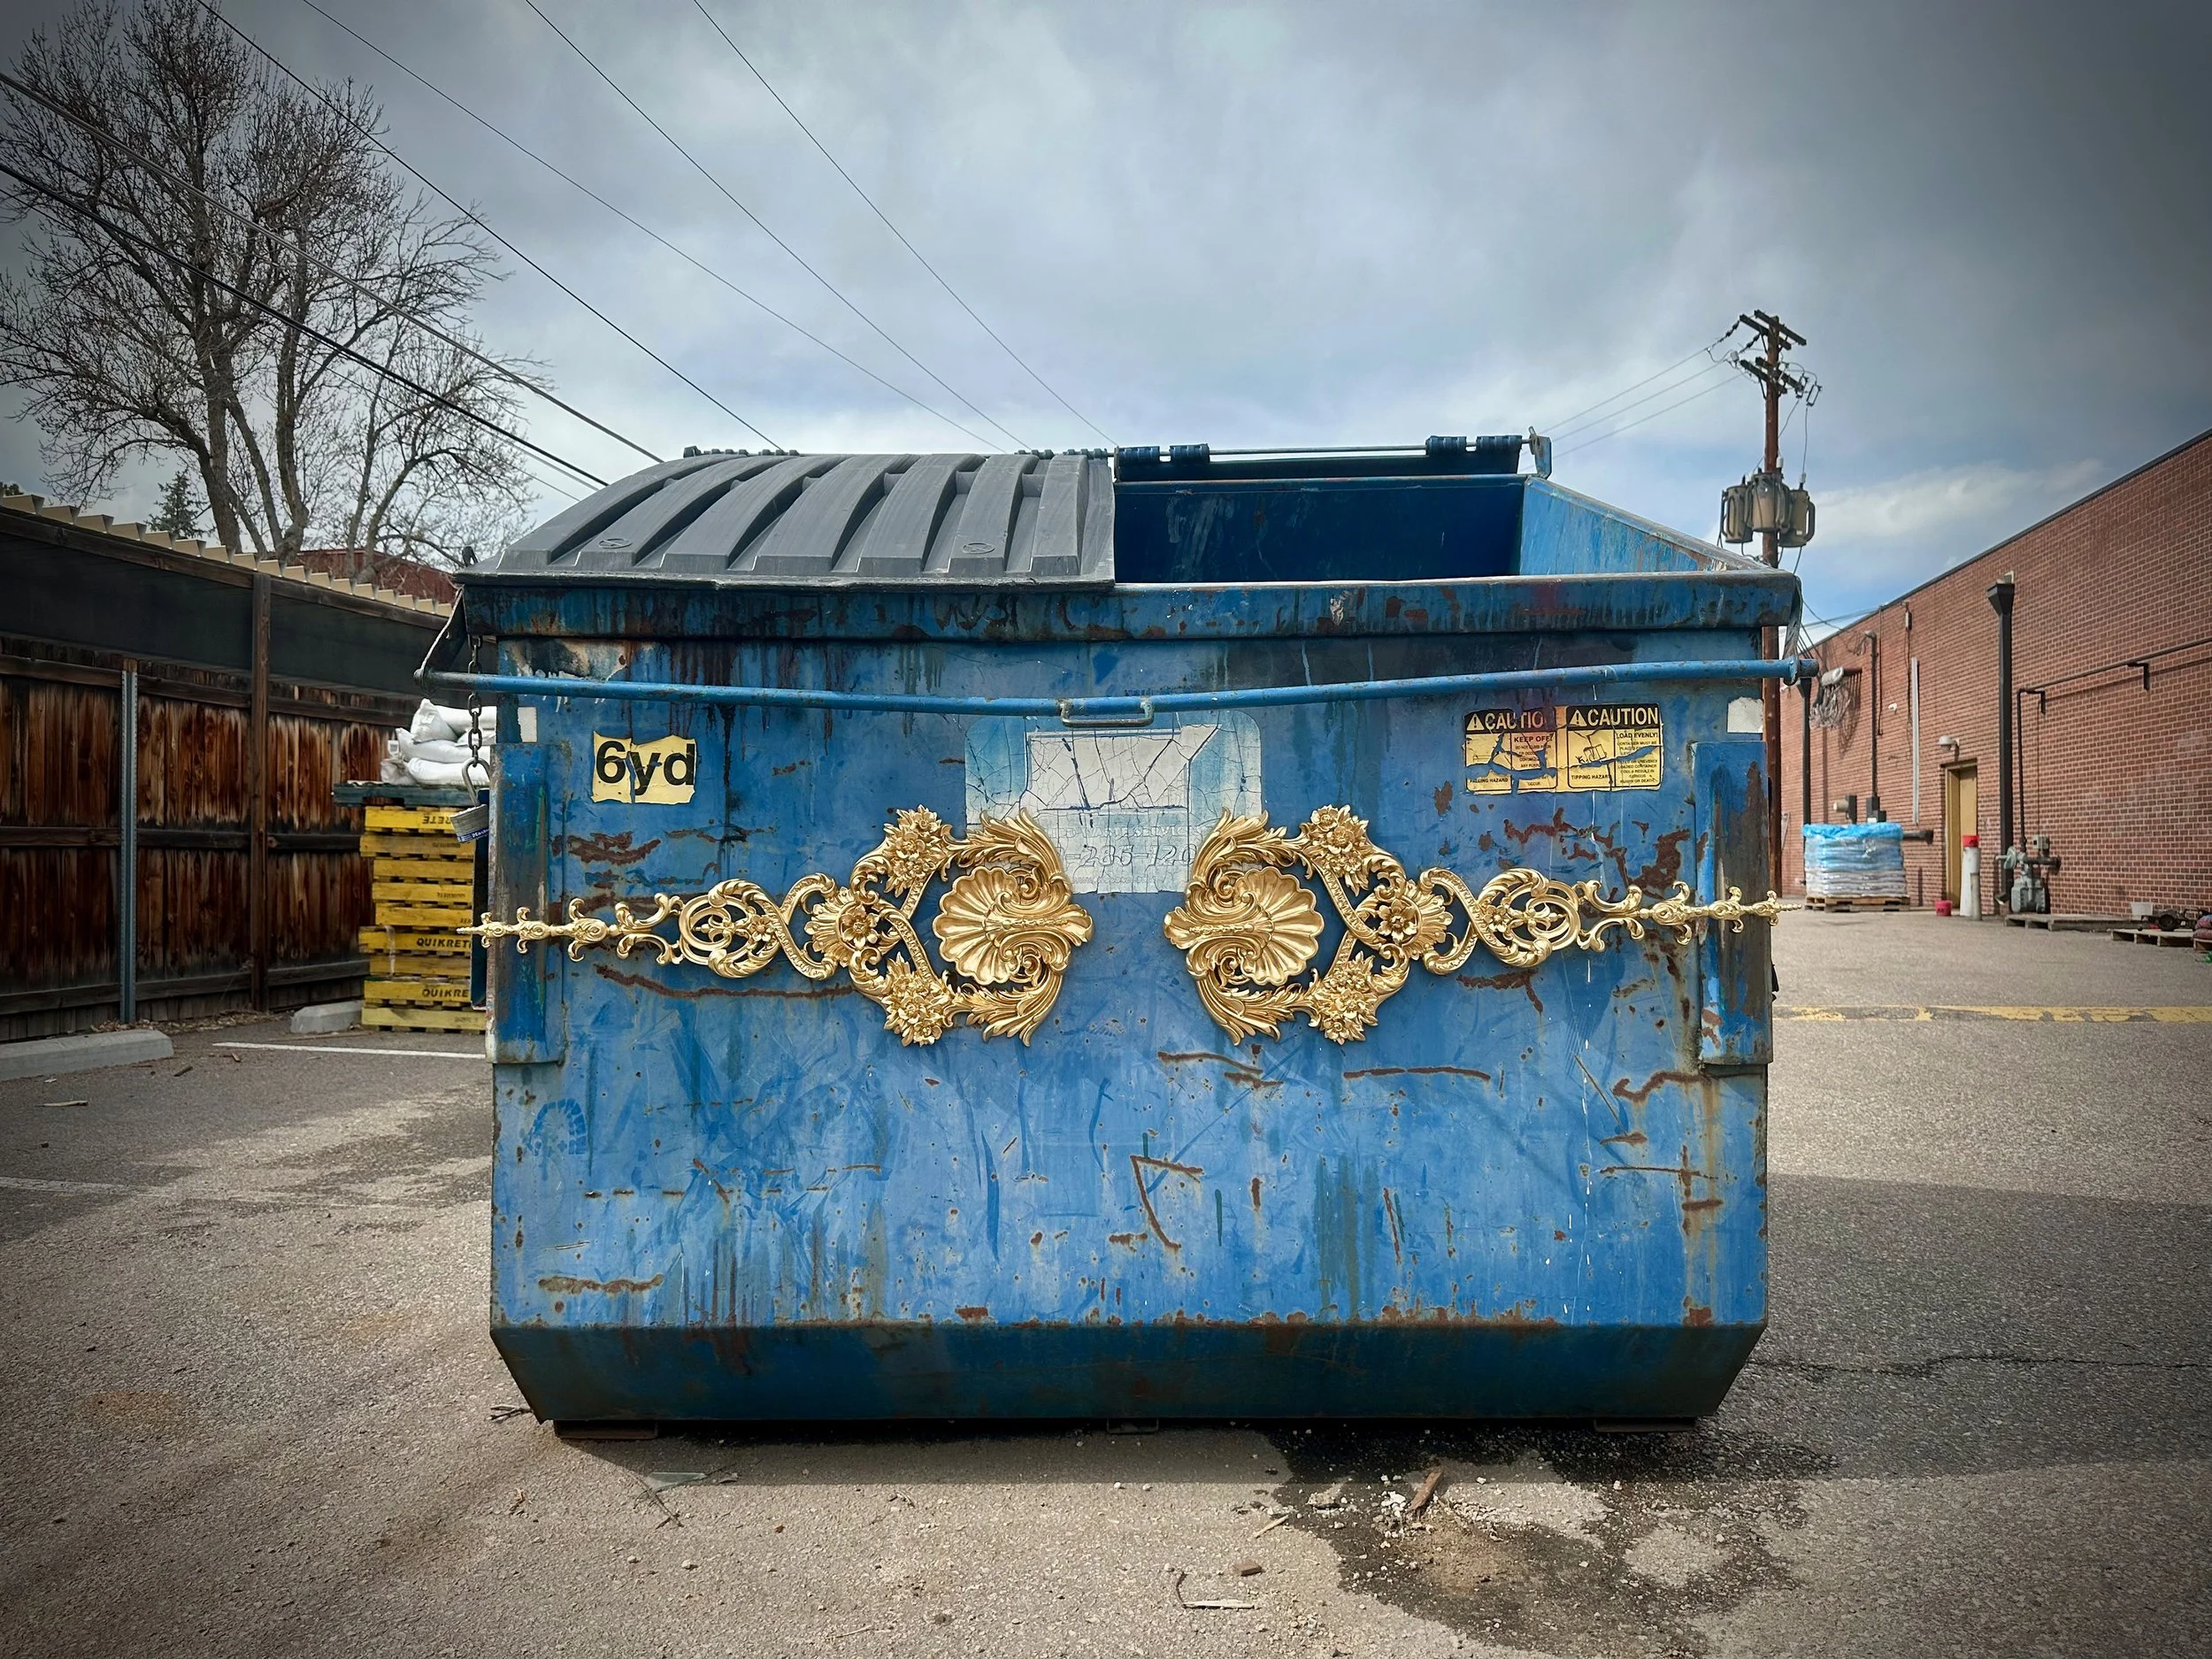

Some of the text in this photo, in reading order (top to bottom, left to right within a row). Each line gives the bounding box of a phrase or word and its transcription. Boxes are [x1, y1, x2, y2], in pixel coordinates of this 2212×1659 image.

[1485, 710, 1546, 730] CAUTIO
[1587, 707, 1659, 726] CAUTION
[595, 740, 696, 796] 6yd
[421, 816, 452, 825] RETE
[422, 988, 469, 998] QUIKRE
